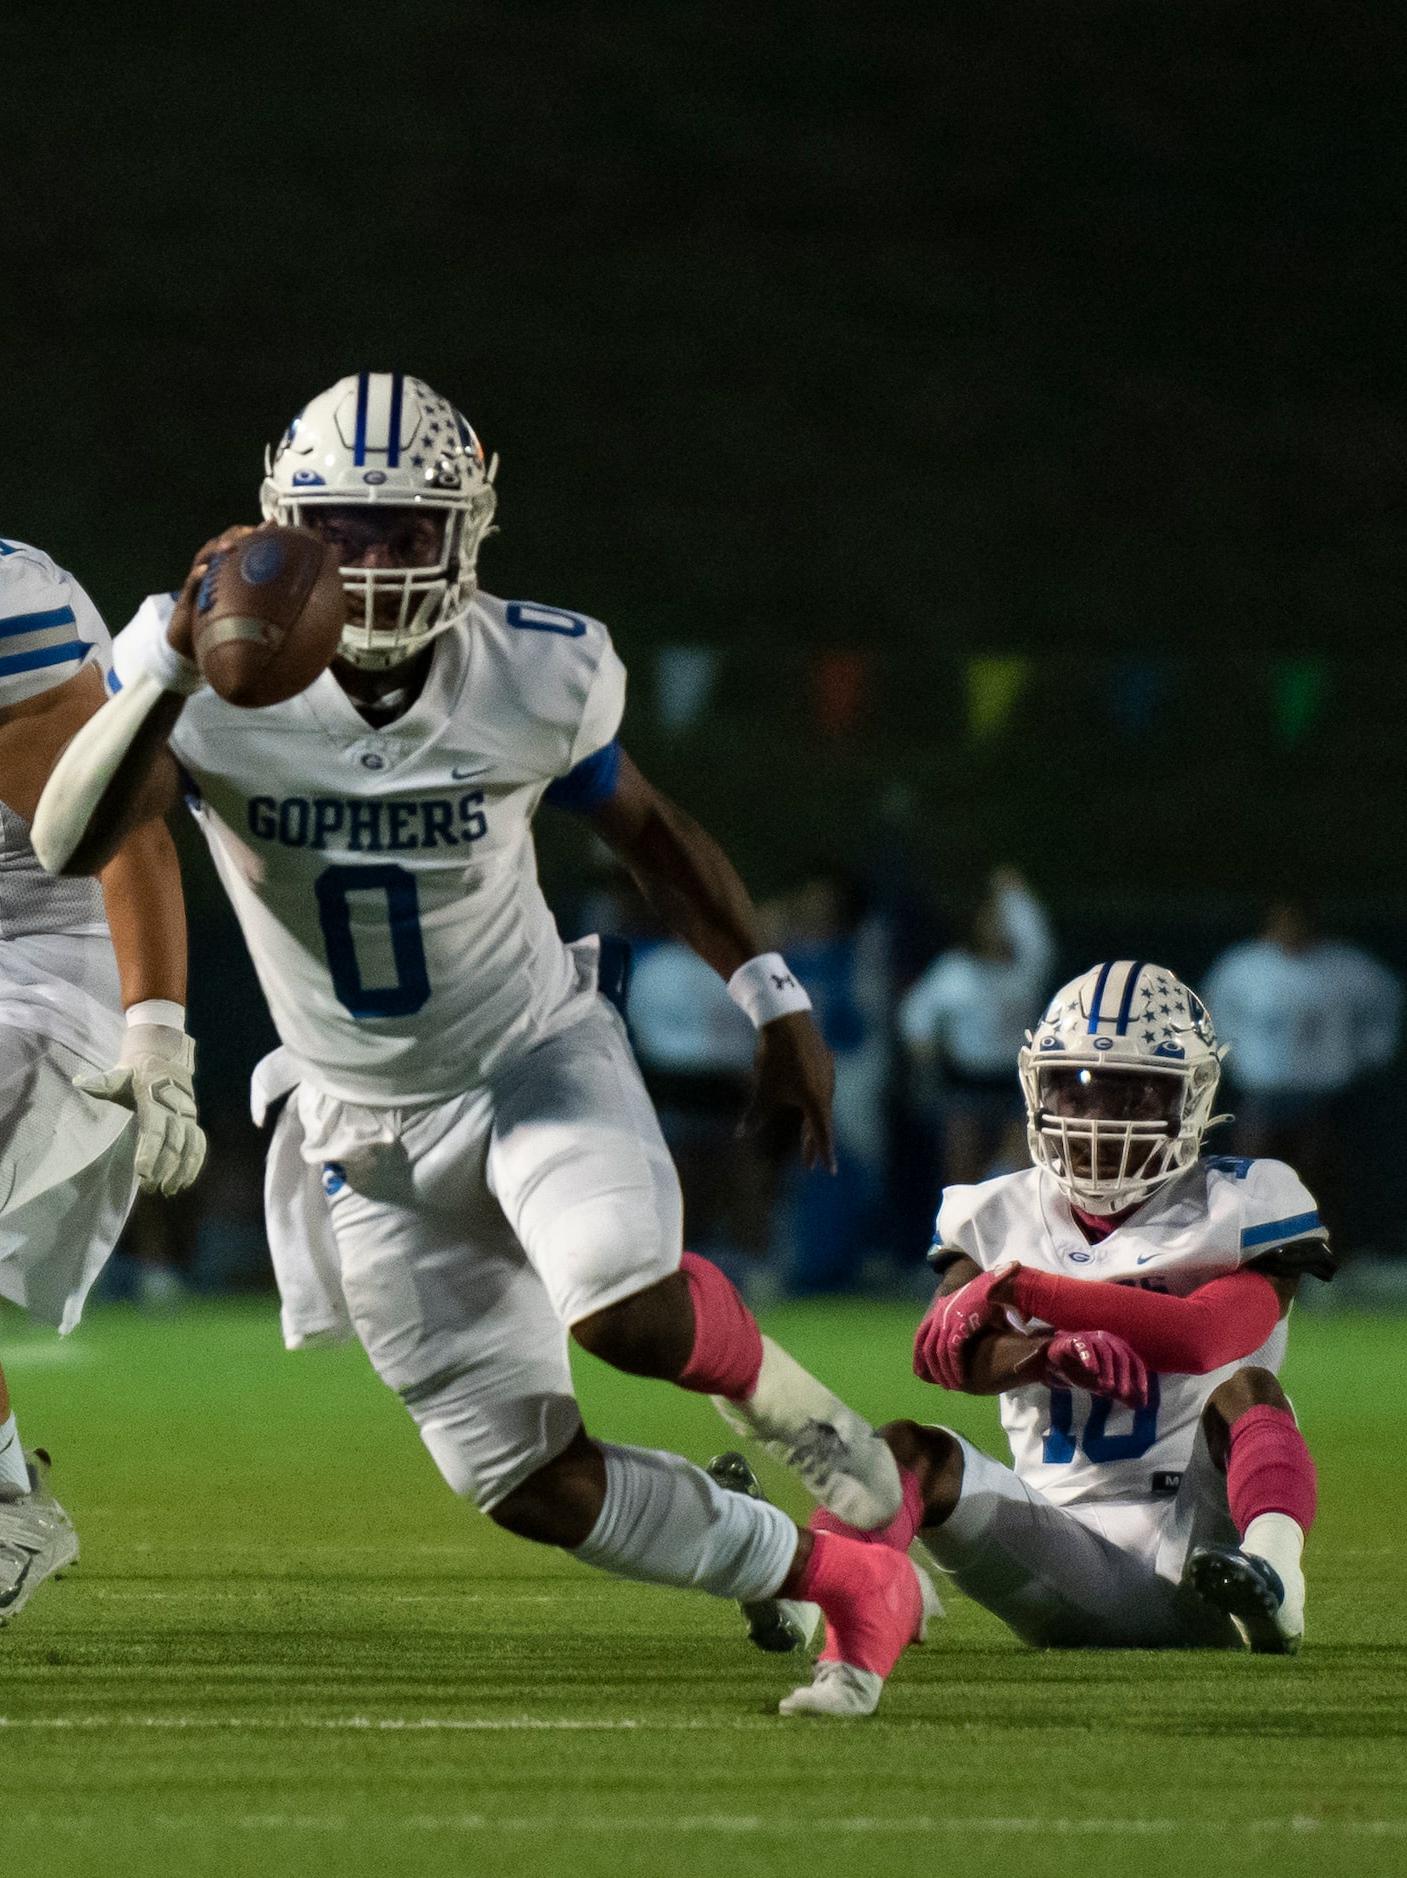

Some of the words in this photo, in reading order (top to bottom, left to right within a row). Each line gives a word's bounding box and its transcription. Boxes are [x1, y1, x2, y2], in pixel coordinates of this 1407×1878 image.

[247, 789, 488, 851] GOPHERS
[314, 862, 432, 1019] 0
[1164, 1475, 1180, 1487] M
